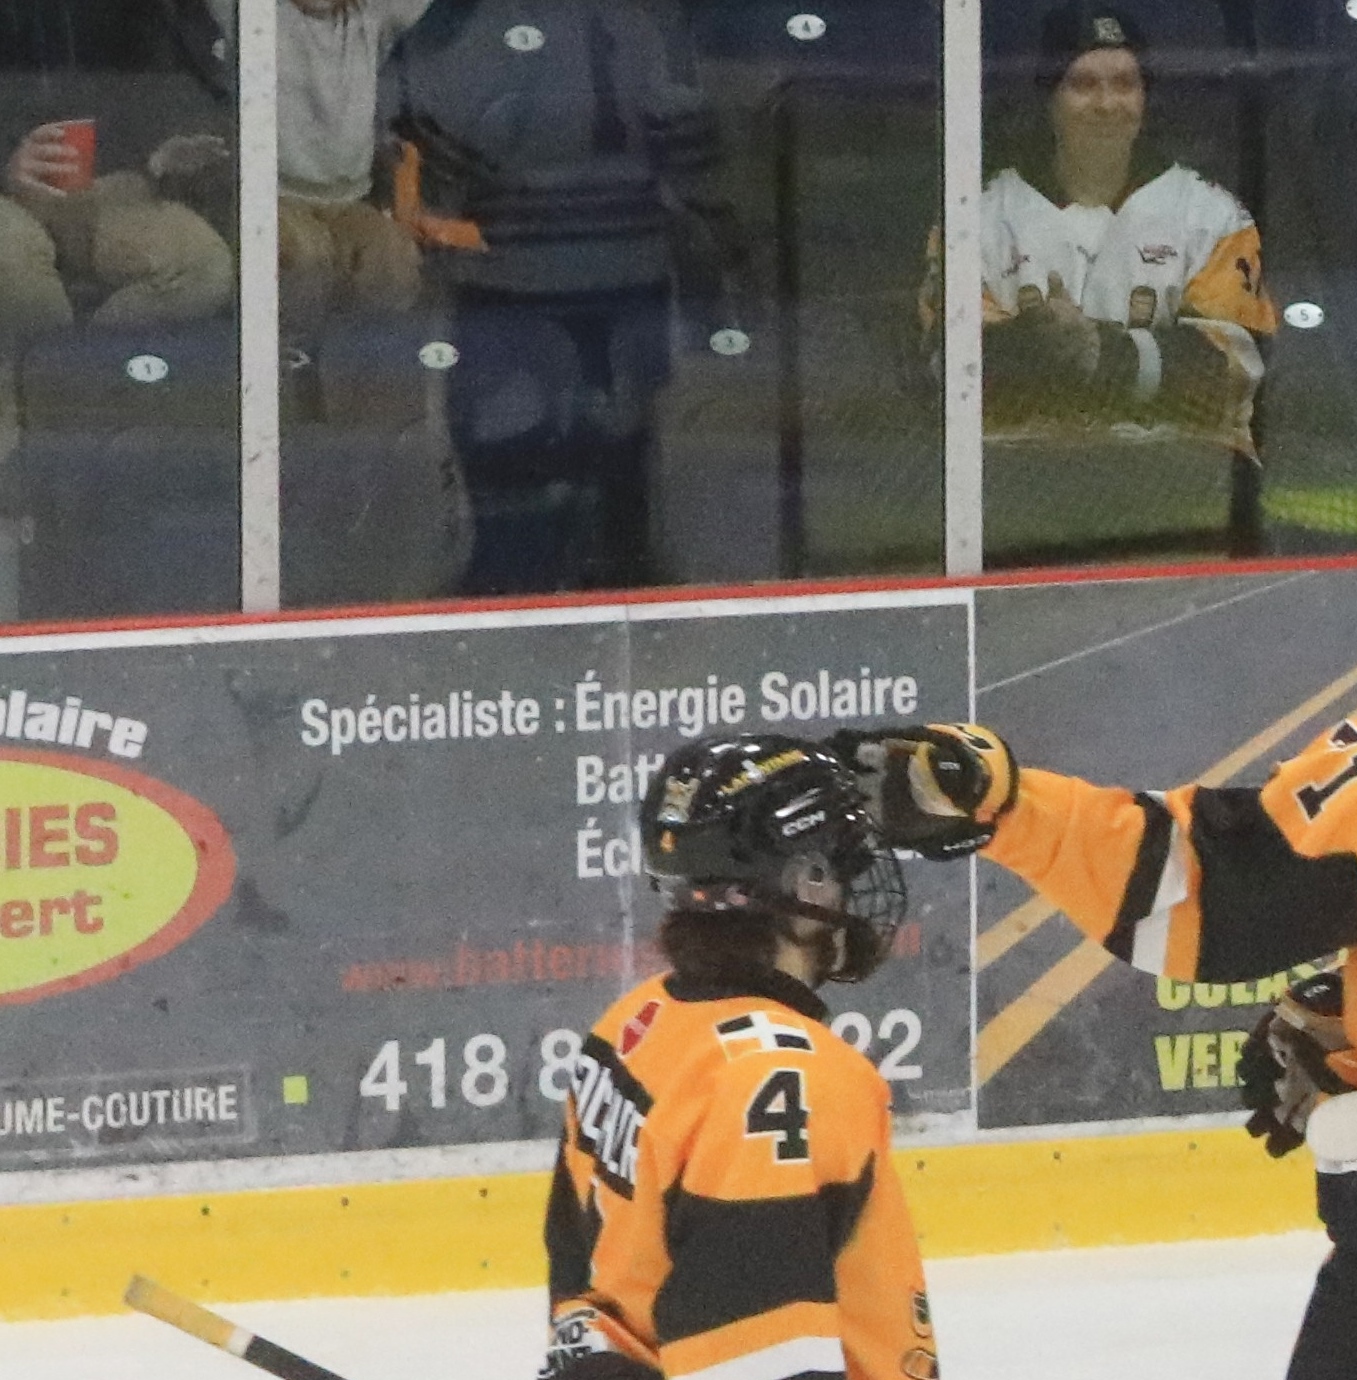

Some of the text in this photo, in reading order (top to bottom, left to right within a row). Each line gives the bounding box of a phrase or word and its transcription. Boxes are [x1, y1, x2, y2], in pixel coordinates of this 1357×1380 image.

[0, 689, 148, 759] laire
[301, 690, 541, 755] Spécialiste
[574, 668, 747, 737] Énergie
[760, 666, 918, 722] Solaire
[782, 810, 826, 838] CCM
[359, 1033, 509, 1112] 418
[744, 1066, 812, 1165] 4
